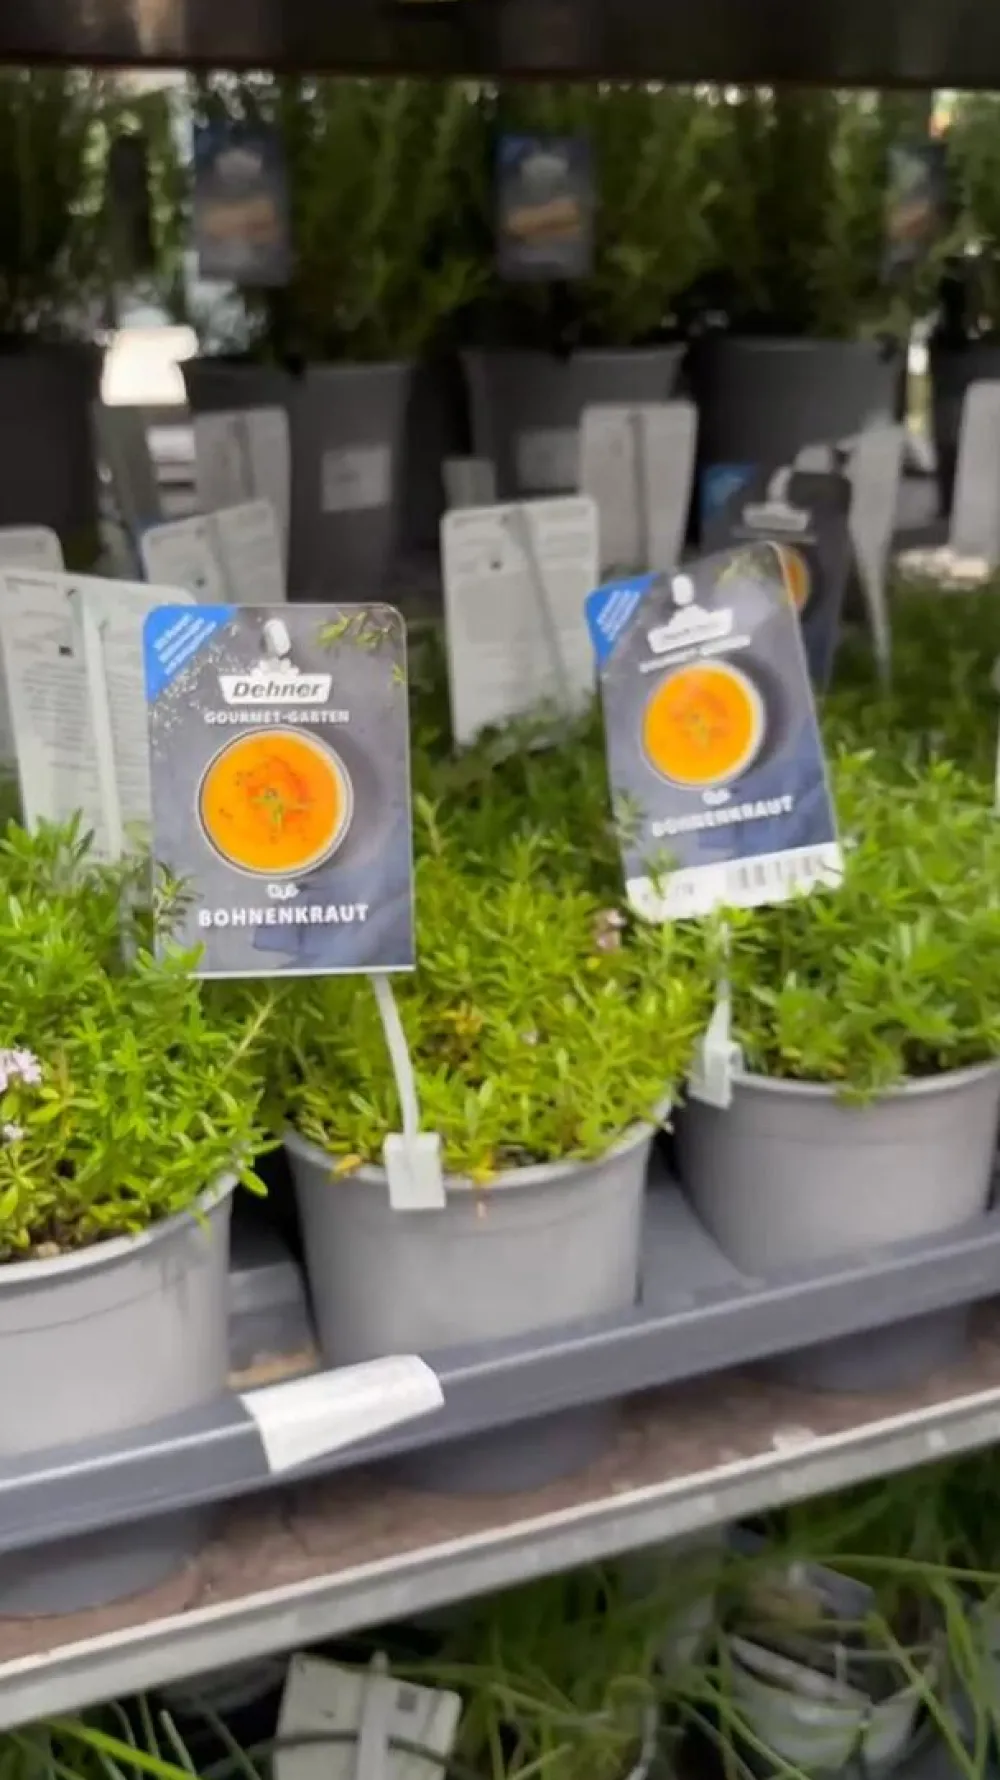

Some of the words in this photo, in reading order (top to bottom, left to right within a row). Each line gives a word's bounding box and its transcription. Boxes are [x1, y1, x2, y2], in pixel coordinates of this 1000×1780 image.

[232, 680, 323, 698] Dehner
[204, 710, 350, 724] GOURMET-GARTEN
[199, 903, 368, 927] BOHNENKRAUT
